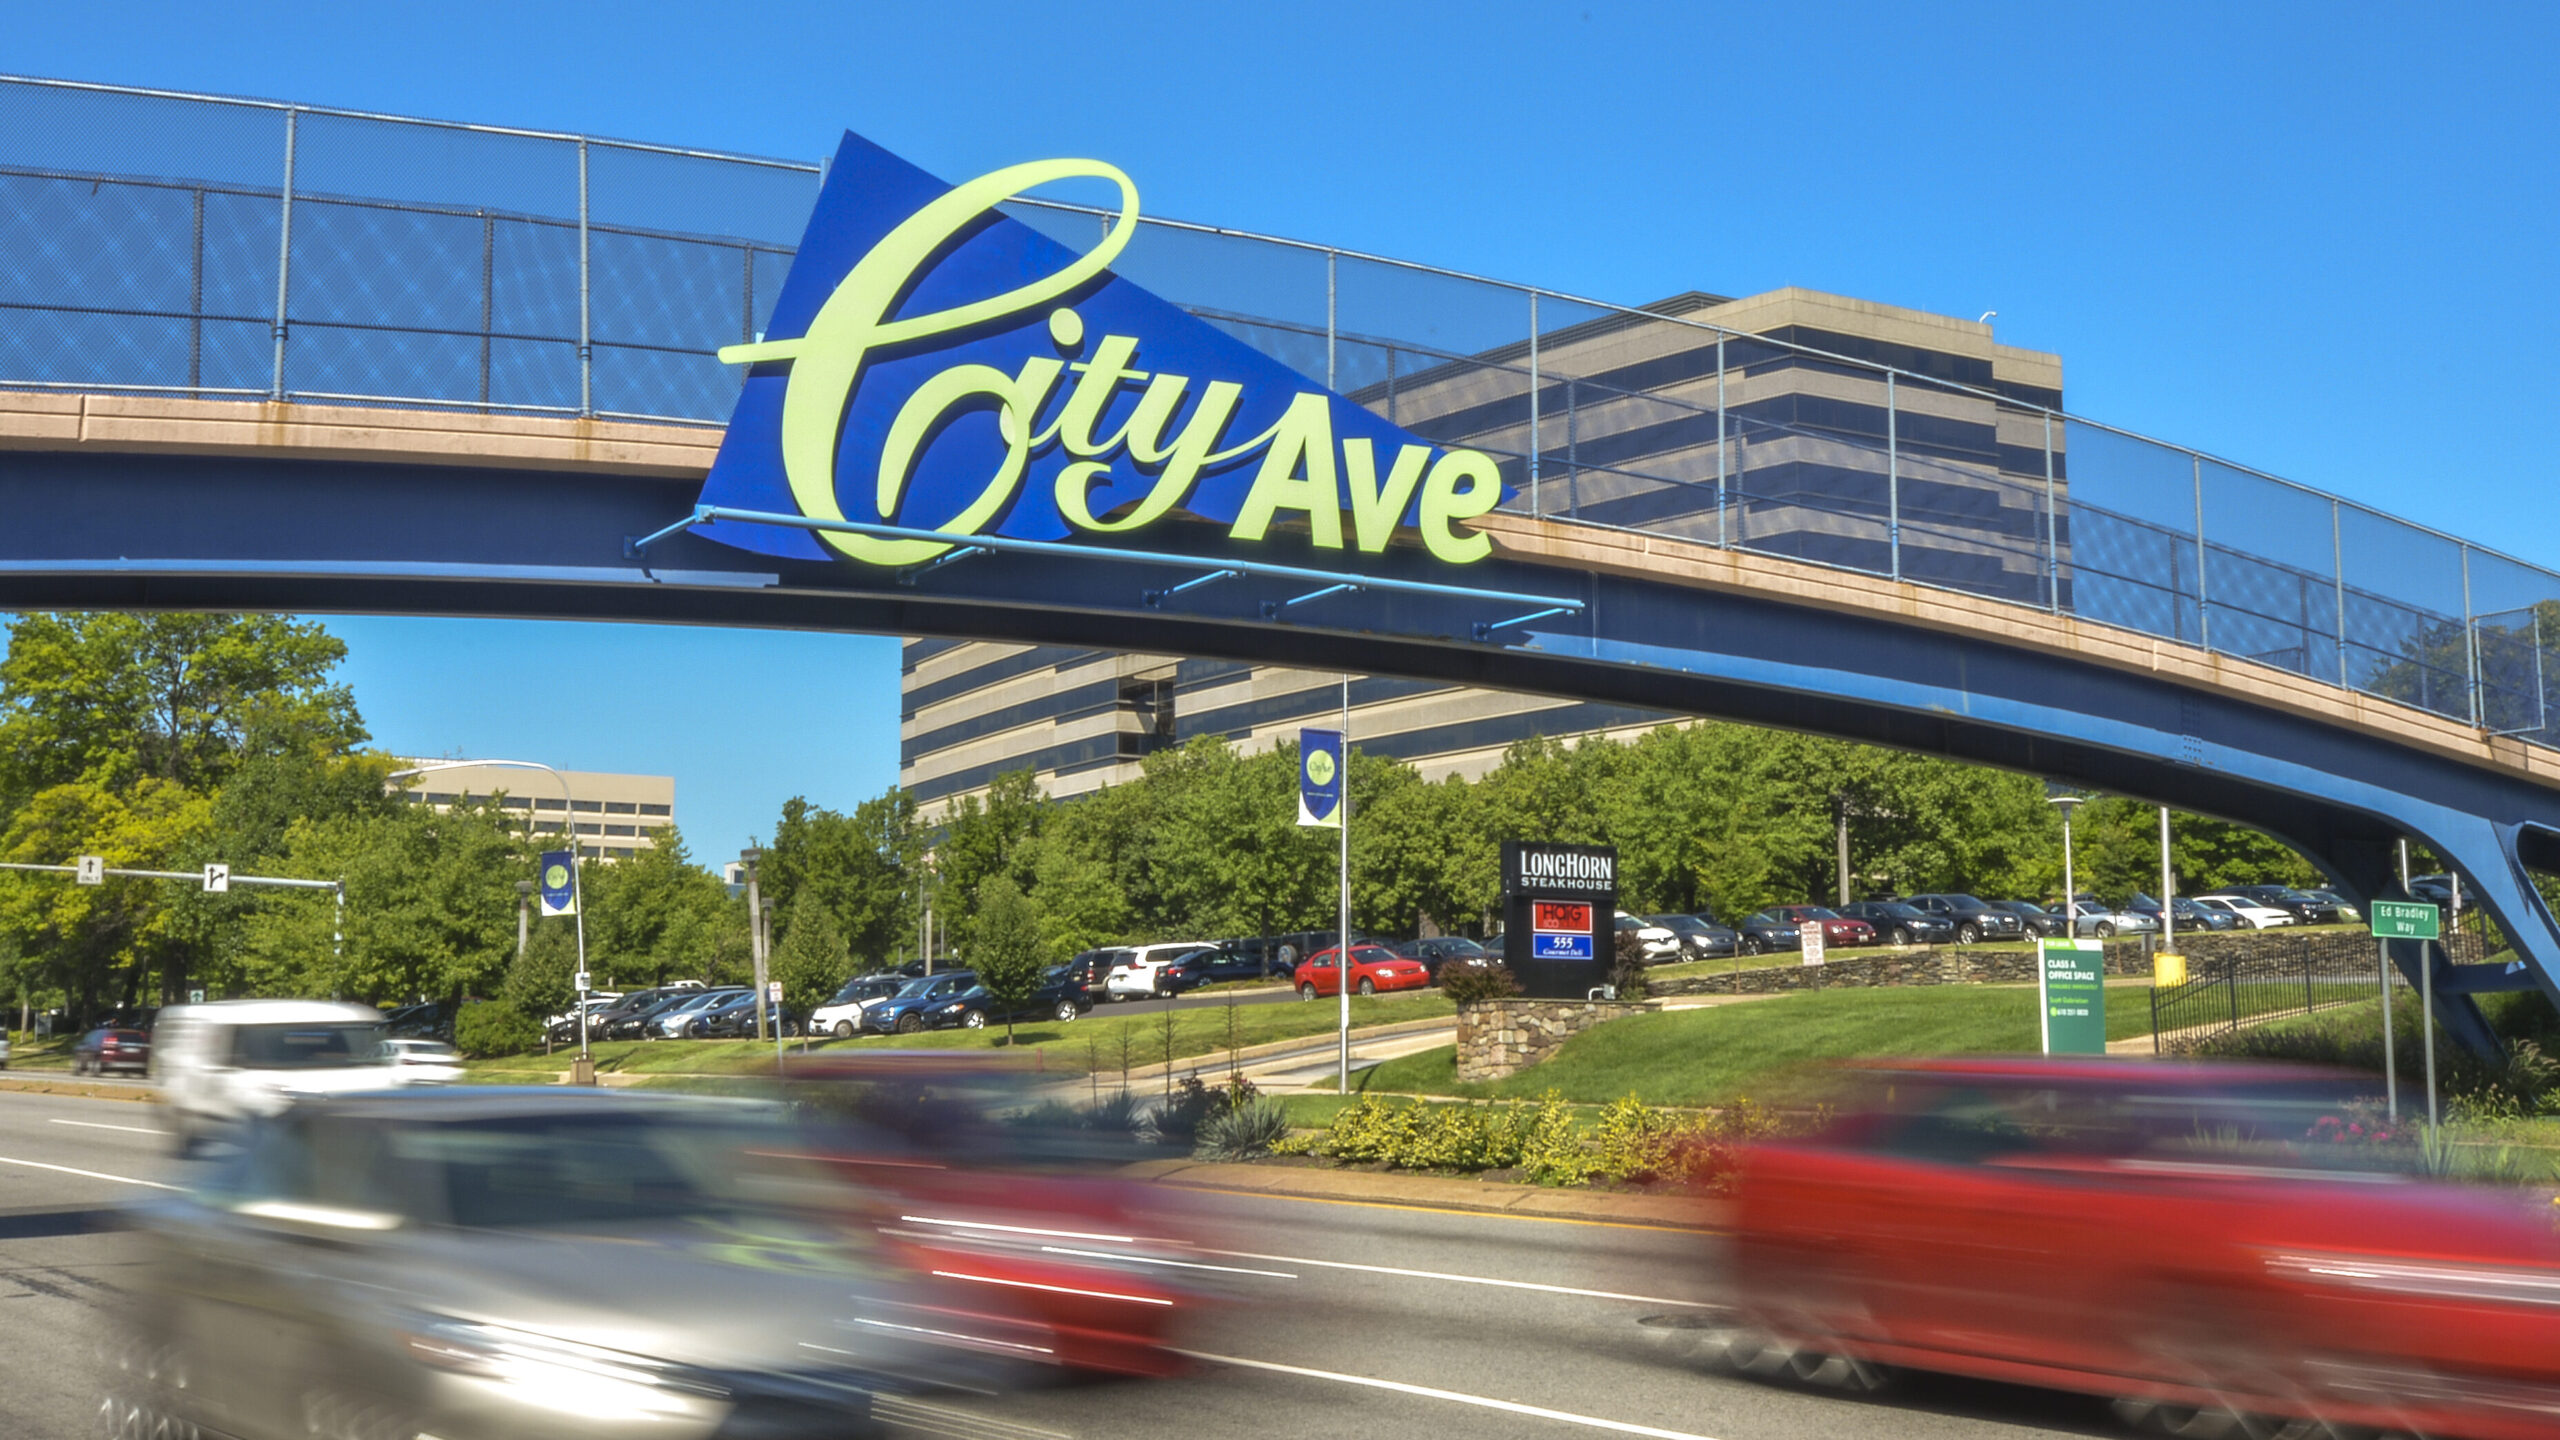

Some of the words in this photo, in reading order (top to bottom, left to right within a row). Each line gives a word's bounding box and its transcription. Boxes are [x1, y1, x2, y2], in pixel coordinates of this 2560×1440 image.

[717, 157, 1279, 566] City
[1228, 391, 1501, 564] Ave
[1520, 850, 1612, 880] LONGHORN
[1521, 876, 1612, 891] STEAKHOUSE
[2381, 905, 2391, 917] Ed
[2395, 906, 2429, 922] Bradley
[2396, 920, 2415, 935] Way
[1553, 936, 1573, 949] 555
[2047, 959, 2069, 969] CLASS
[2070, 960, 2076, 969] A
[2048, 970, 2072, 980] OFFICE
[2073, 971, 2095, 981] SPACE
